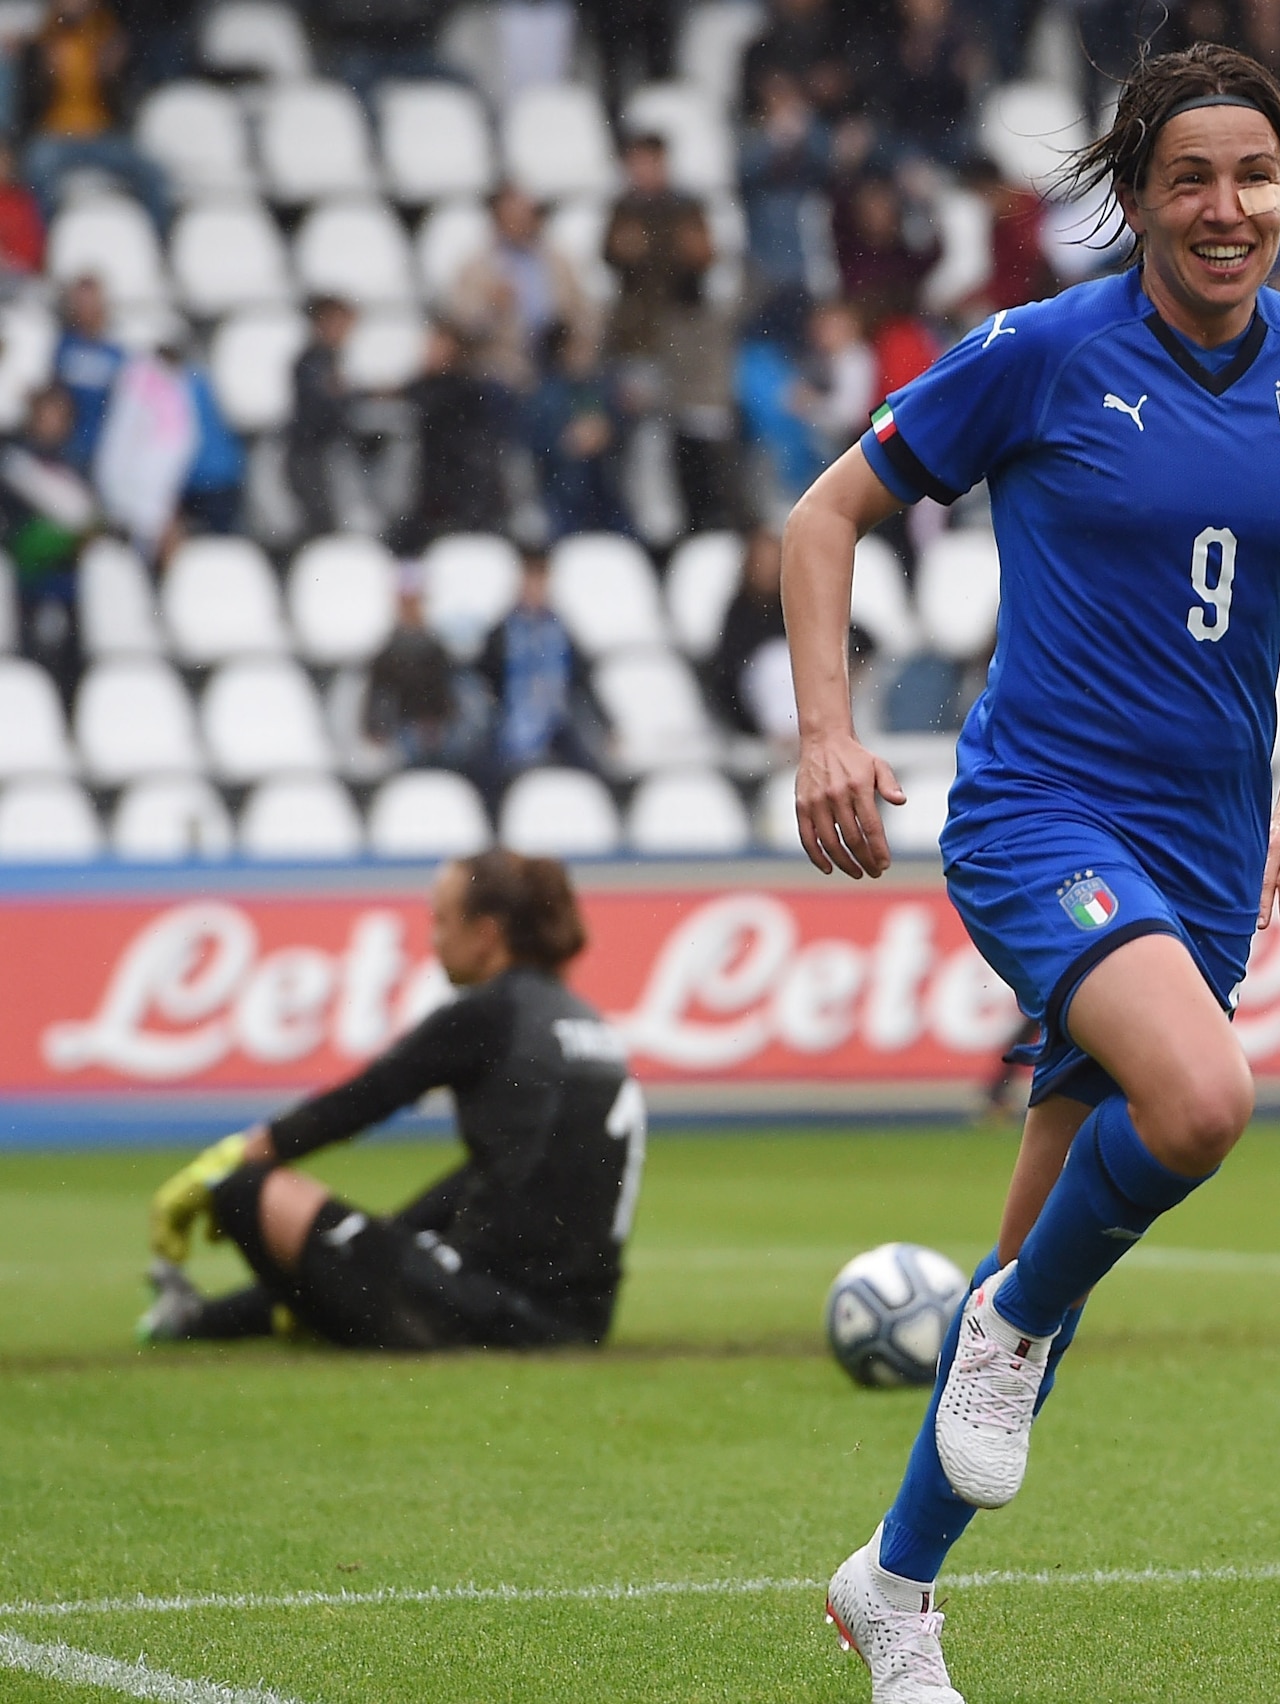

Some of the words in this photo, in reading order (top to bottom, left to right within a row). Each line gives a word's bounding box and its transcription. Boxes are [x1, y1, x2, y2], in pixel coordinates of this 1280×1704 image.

[1187, 526, 1237, 642] 9
[602, 893, 1018, 1070] Lete
[604, 1075, 647, 1241] 1
